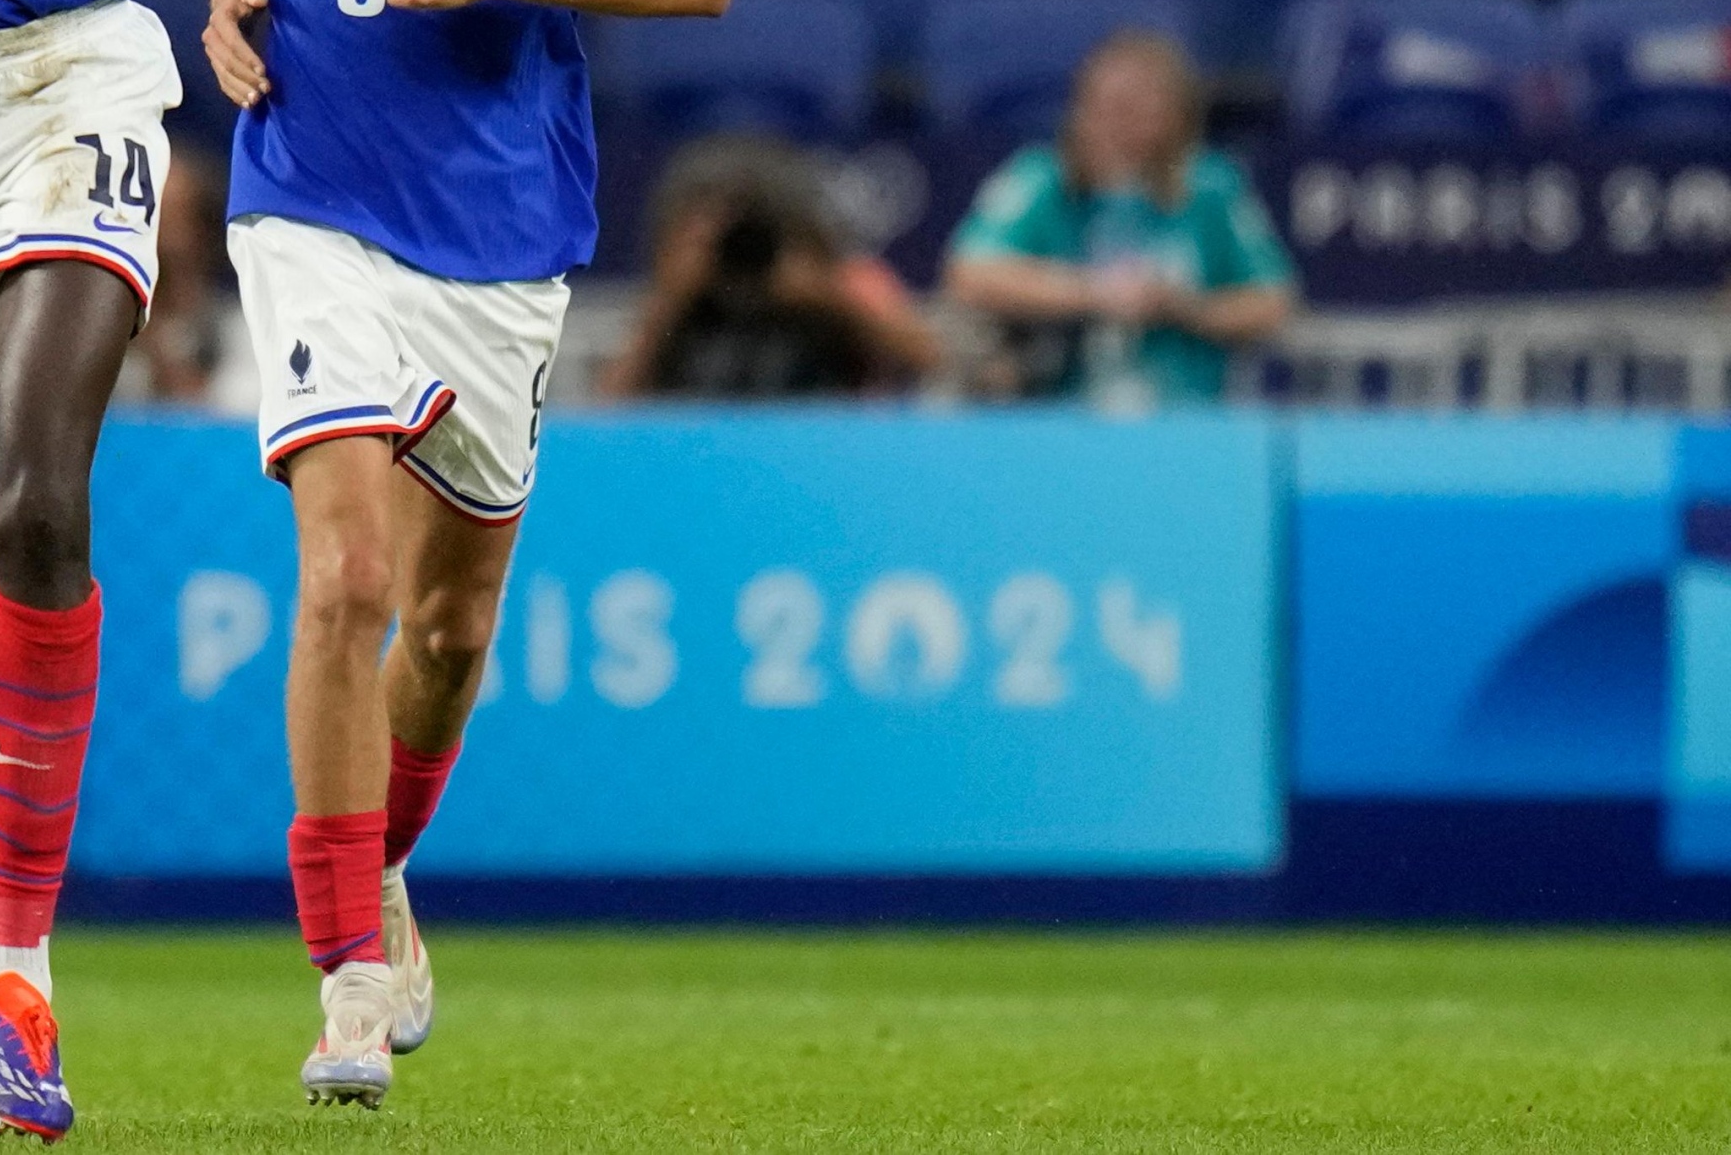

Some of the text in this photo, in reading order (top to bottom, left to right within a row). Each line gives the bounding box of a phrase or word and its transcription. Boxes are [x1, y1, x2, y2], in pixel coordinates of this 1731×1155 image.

[74, 134, 155, 228] 14
[287, 384, 318, 400] FRANCE
[176, 568, 1186, 707] PIS 2024
